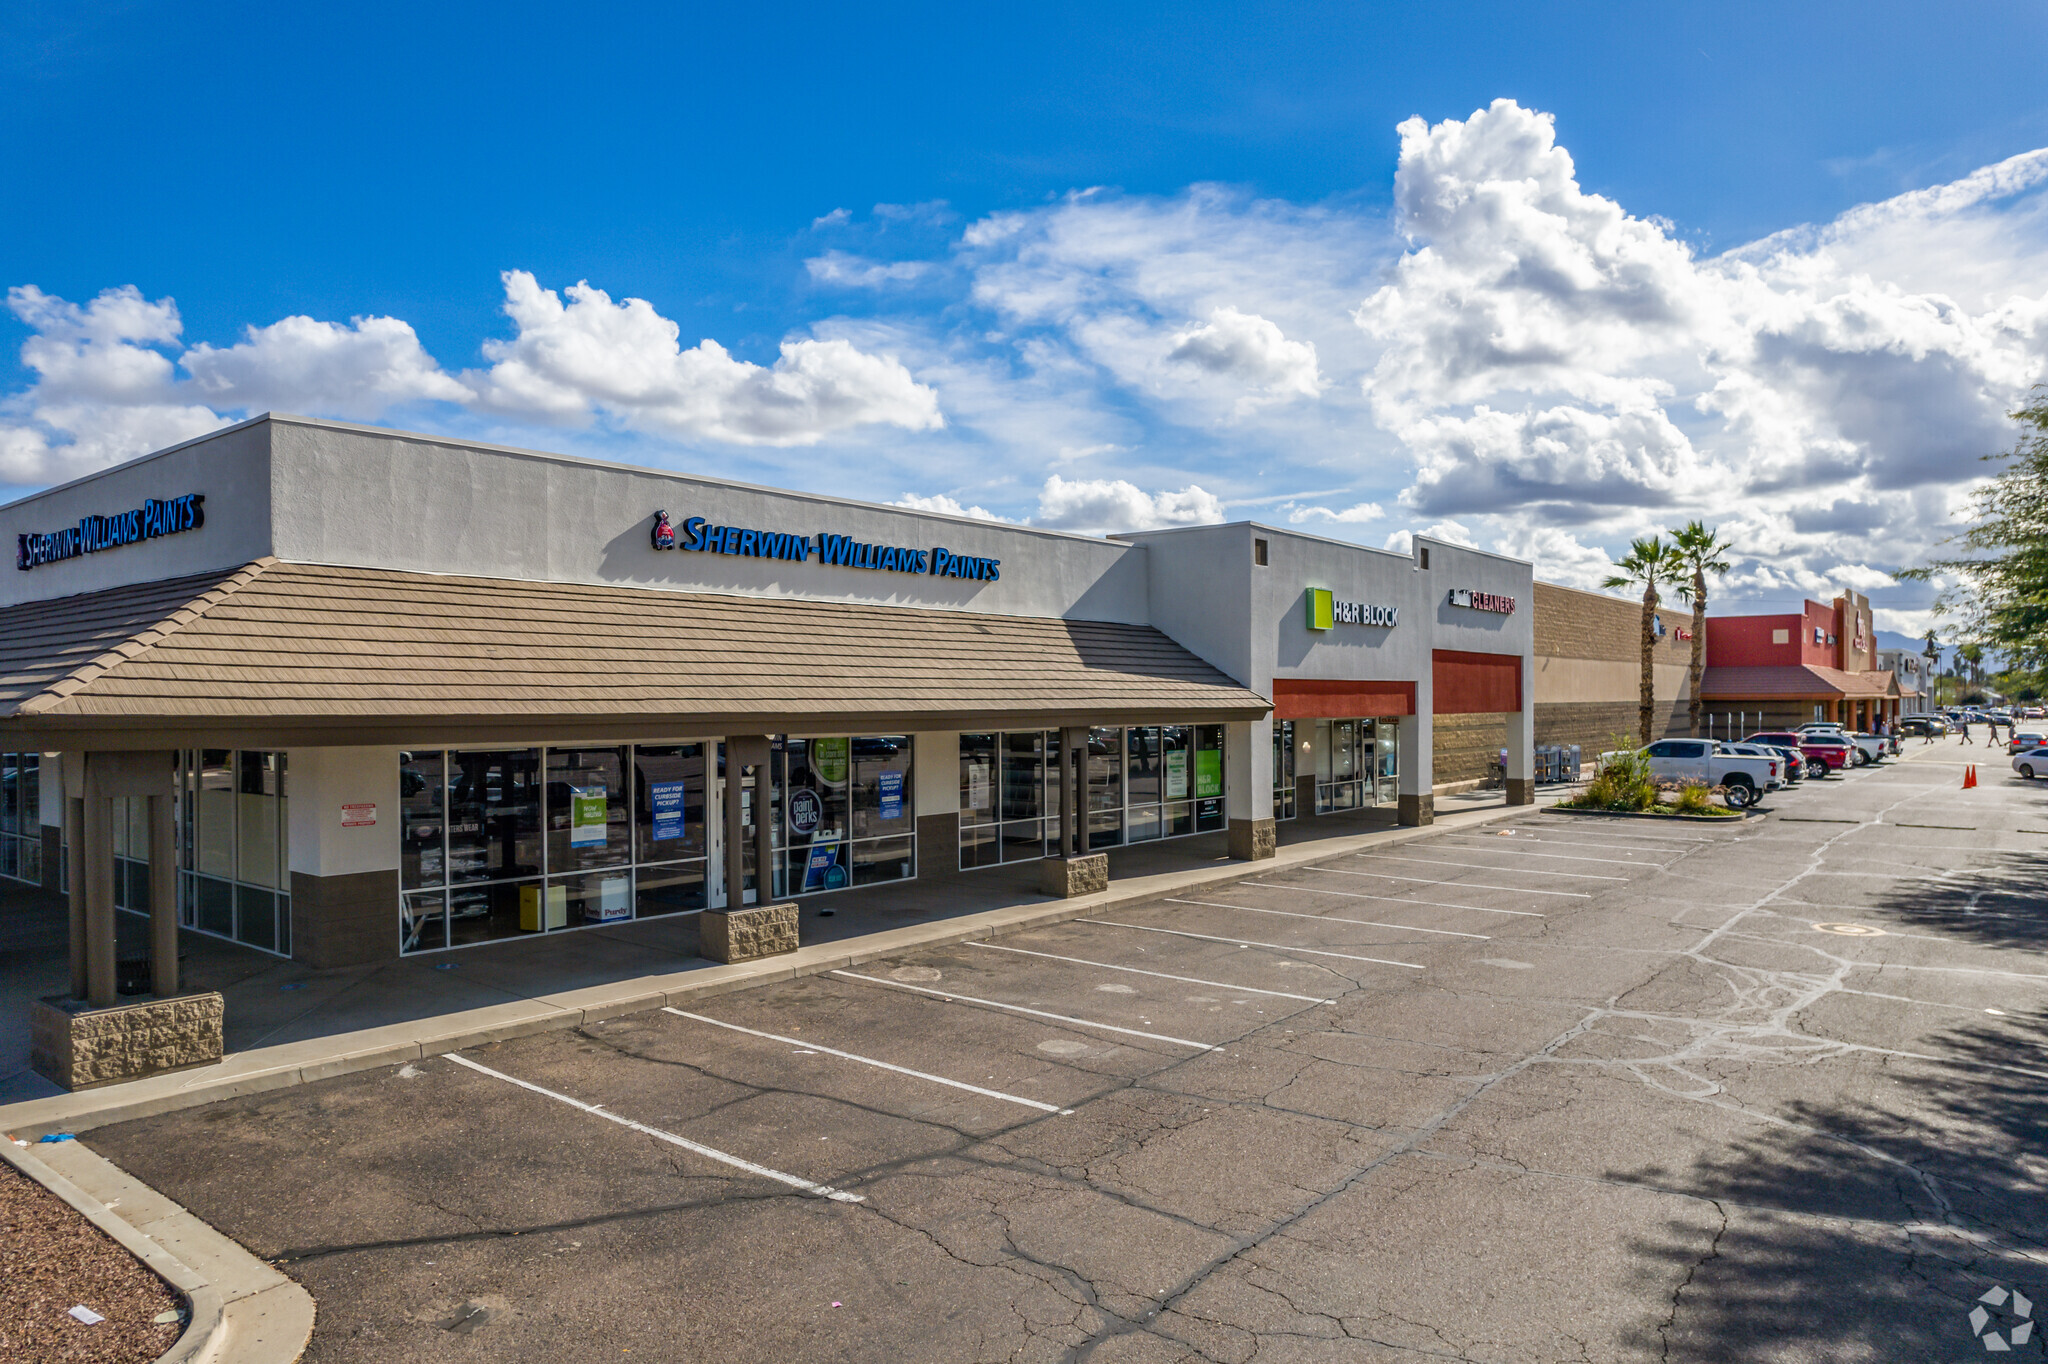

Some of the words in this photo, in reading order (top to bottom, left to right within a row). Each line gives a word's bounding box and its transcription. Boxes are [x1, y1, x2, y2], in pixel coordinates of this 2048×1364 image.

[25, 509, 139, 567] SHERWIN-WILLIAMS
[143, 494, 198, 539] PAINTS
[682, 516, 928, 574] SHERWIN-WILLIAMS
[932, 547, 1001, 583] PAINTS
[1472, 591, 1516, 615] CLEANERS
[1333, 600, 1360, 624] H&R
[1363, 604, 1399, 627] BLOCK
[653, 786, 671, 794] READY
[1197, 784, 1219, 794] BLOCK
[656, 799, 680, 807] PICKUP?
[793, 798, 814, 815] paint
[795, 810, 818, 826] perks
[463, 823, 479, 832] WEAR
[604, 906, 627, 916] Purdy
